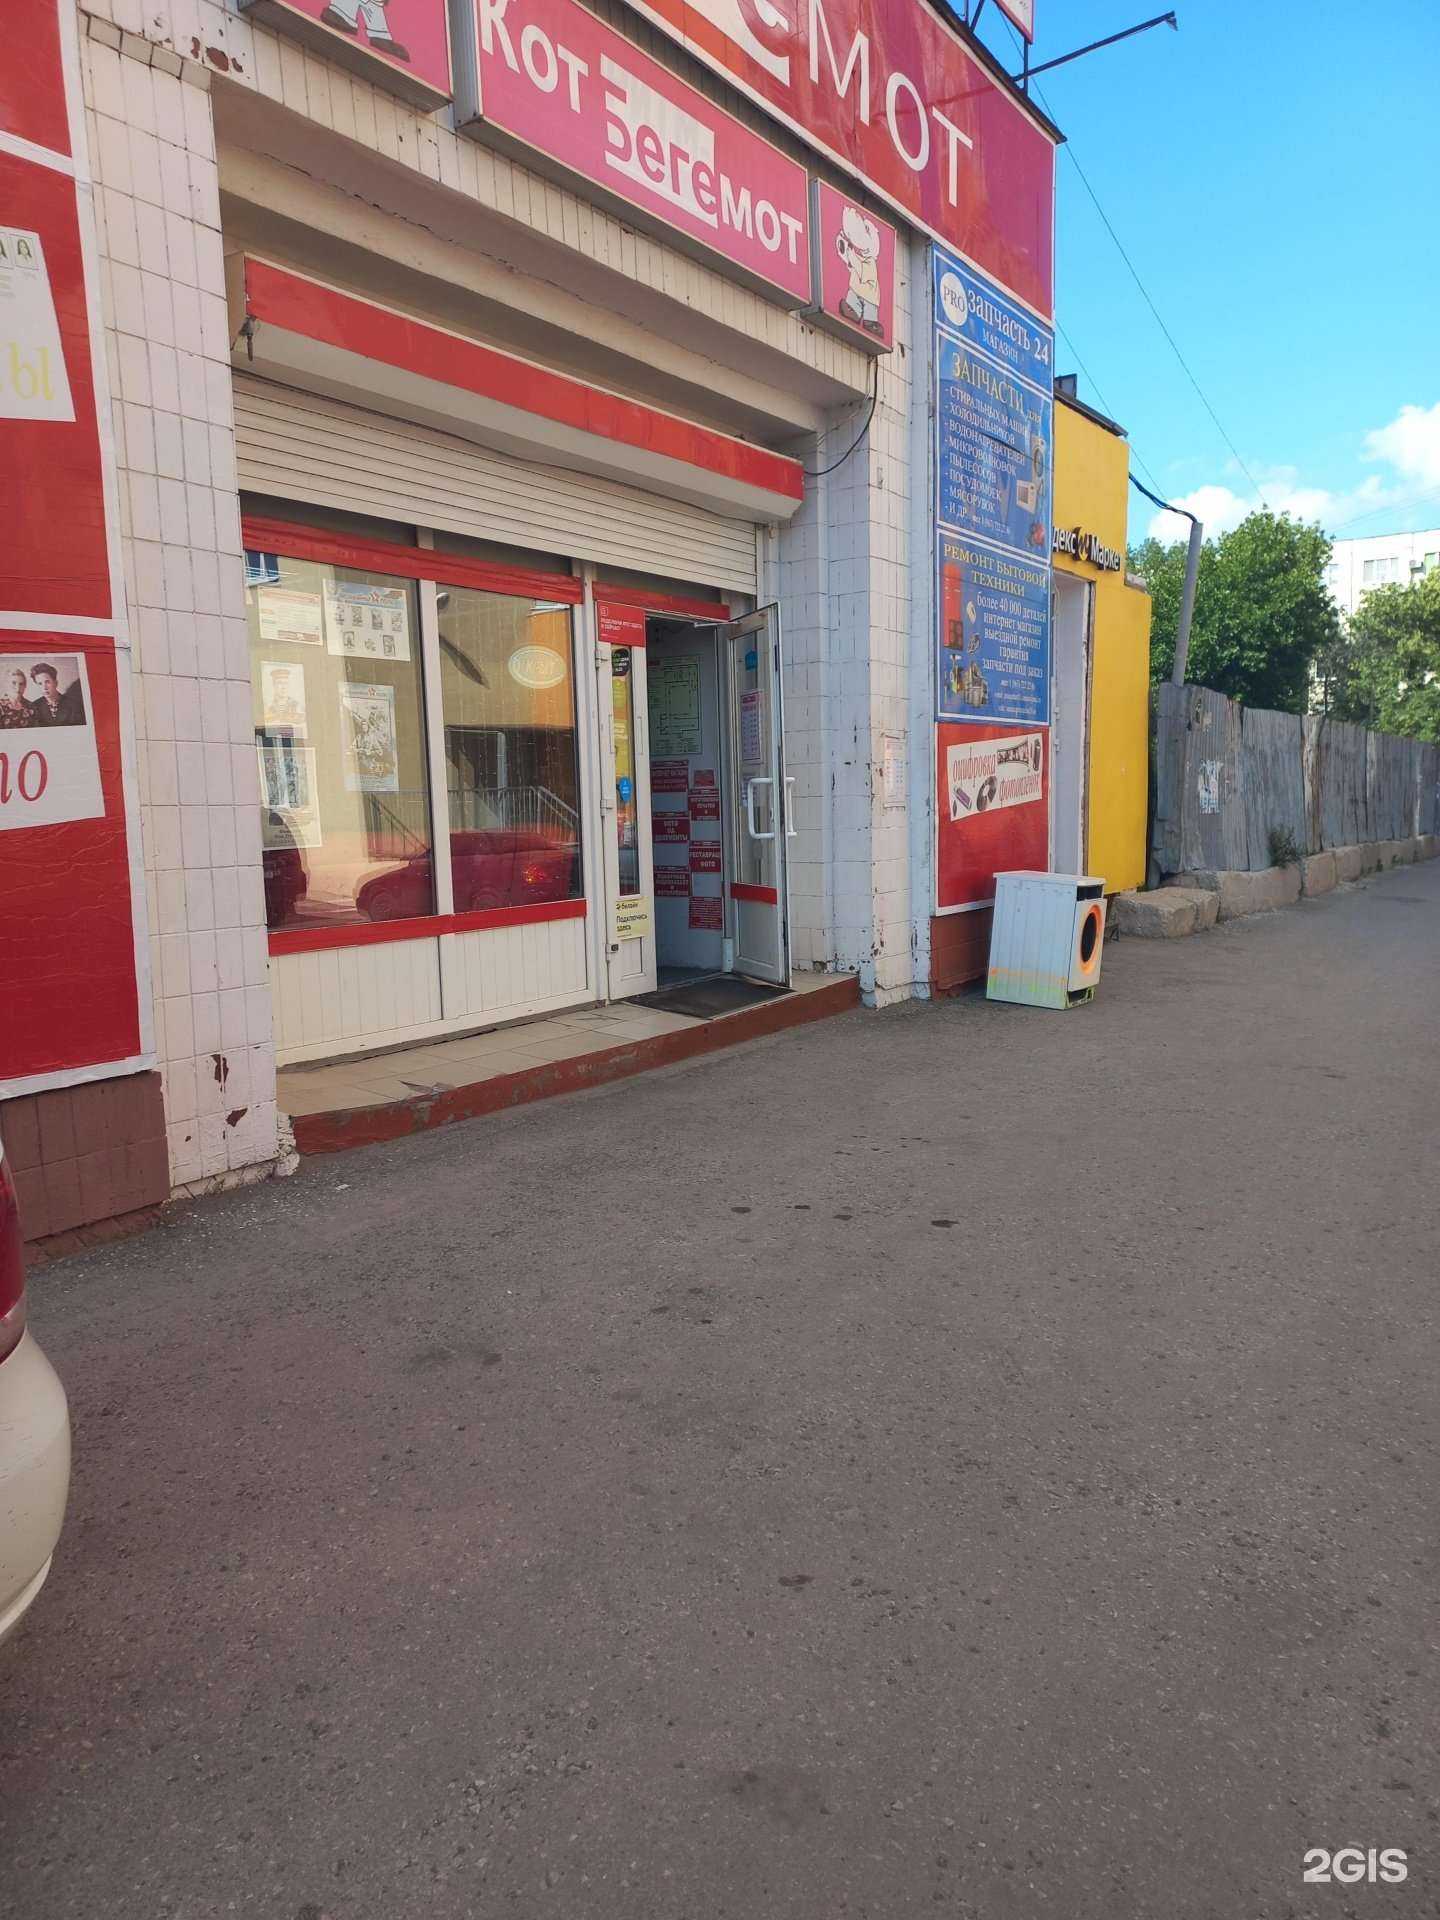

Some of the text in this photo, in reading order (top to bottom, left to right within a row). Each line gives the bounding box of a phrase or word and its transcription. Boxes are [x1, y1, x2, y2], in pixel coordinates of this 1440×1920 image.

[1034, 337, 1049, 366] 24
[952, 352, 1024, 414] ЗАПЧАСТИ
[950, 386, 1001, 422] СТИРАЛЬНЫХ
[1053, 528, 1077, 554] декс
[943, 543, 1048, 590] РЕМОНТ БЫТОВОЙ
[971, 570, 1025, 598] ТЕХНИКИ
